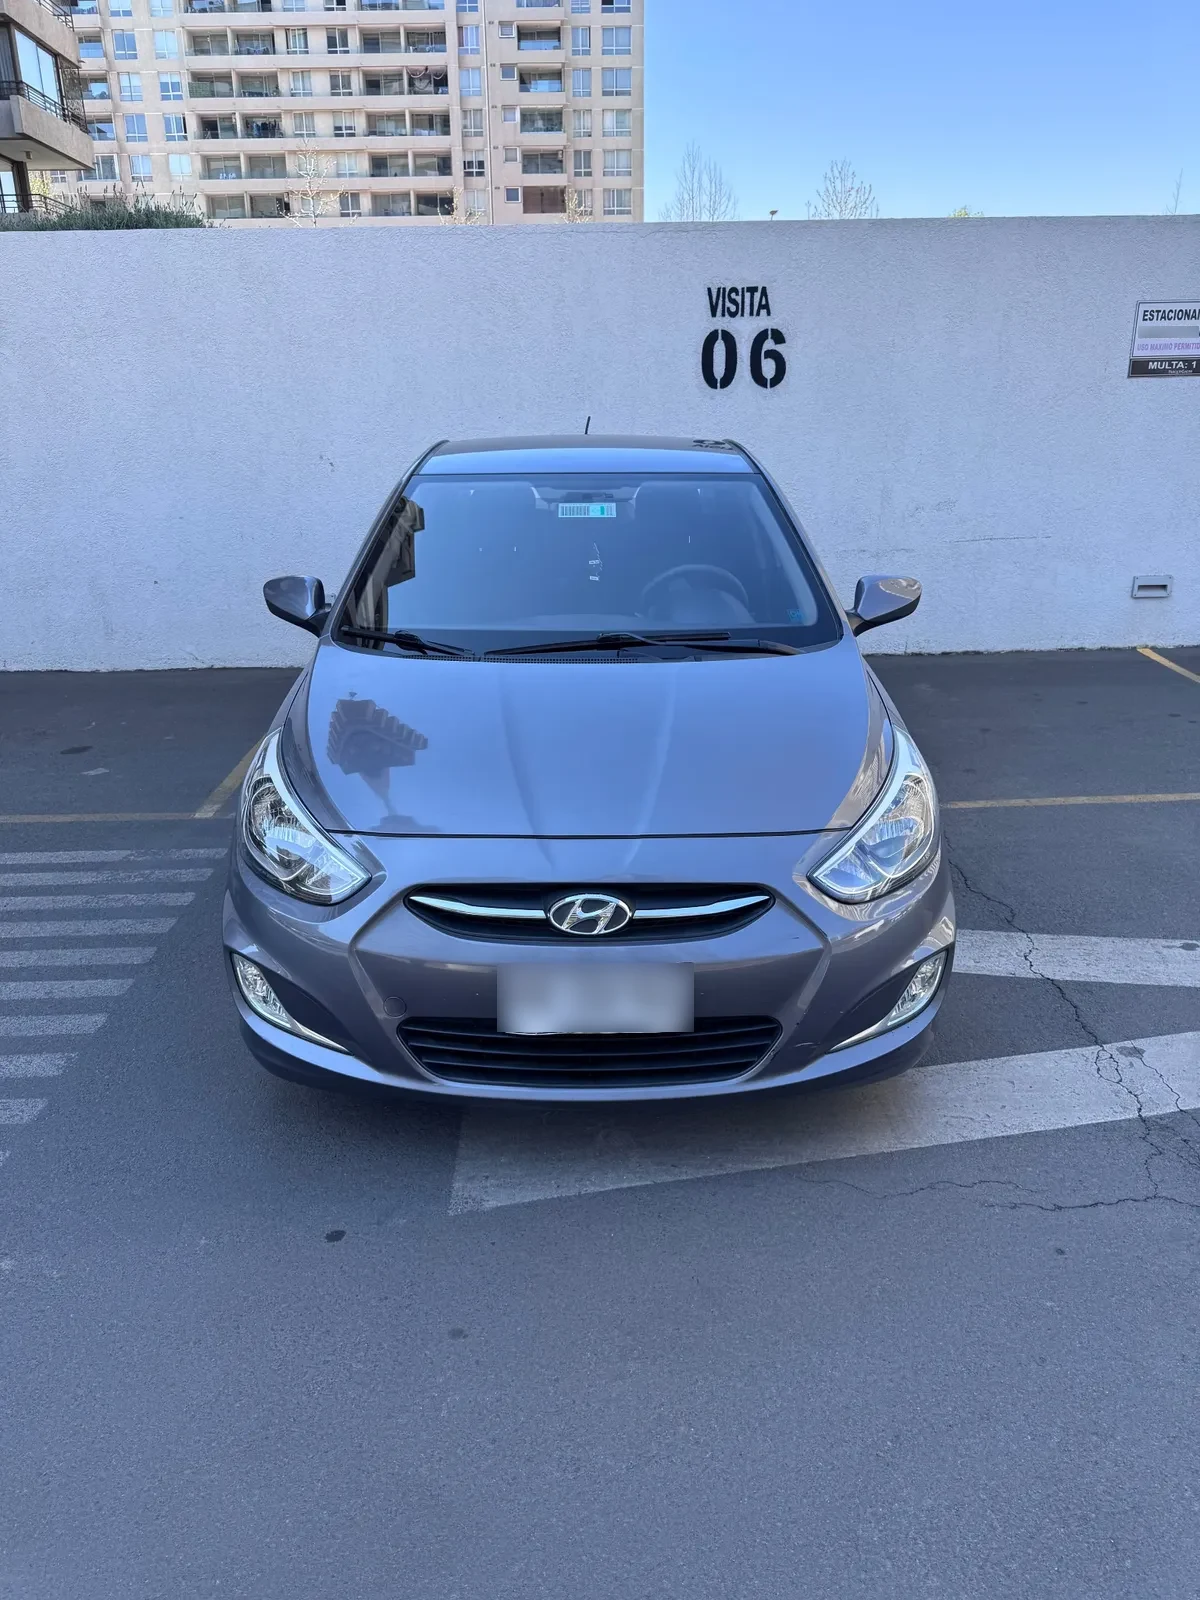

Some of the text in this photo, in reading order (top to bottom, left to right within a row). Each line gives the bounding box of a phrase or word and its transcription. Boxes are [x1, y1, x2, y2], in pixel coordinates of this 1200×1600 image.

[707, 286, 771, 318] VISITA
[701, 328, 787, 389] 06
[1148, 361, 1188, 369] MULTA:
